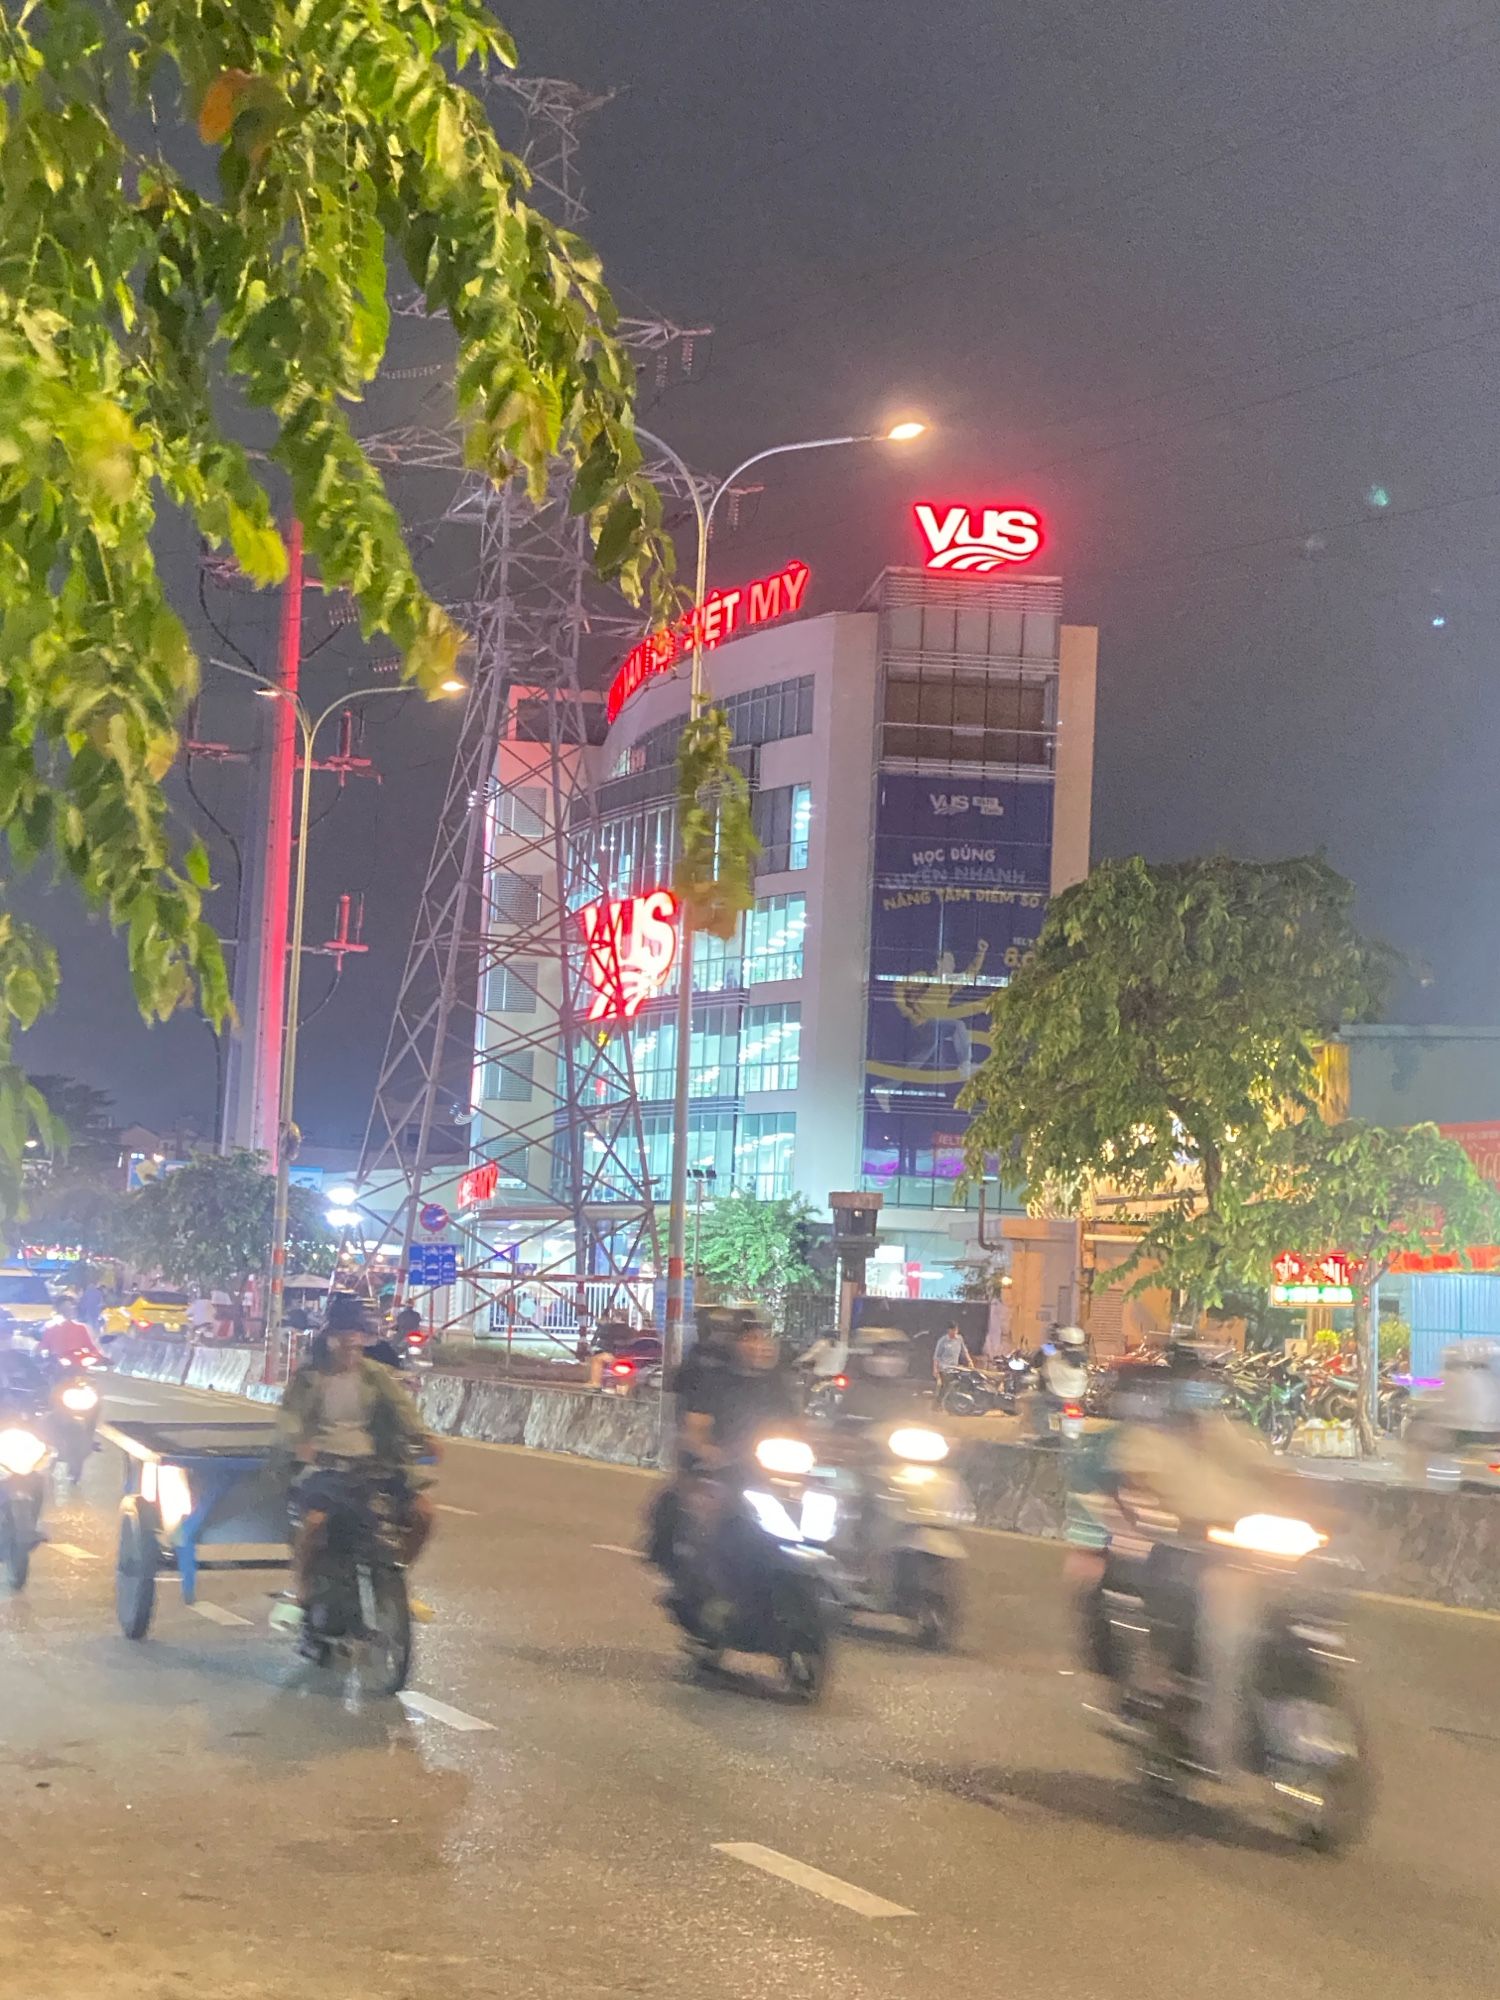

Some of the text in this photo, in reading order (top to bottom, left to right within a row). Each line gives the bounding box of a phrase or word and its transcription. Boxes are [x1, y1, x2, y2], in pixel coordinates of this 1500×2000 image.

[914, 505, 1040, 556] VUS
[749, 562, 808, 624] MỸ
[929, 794, 970, 811] VUS
[912, 850, 945, 867] HỌC
